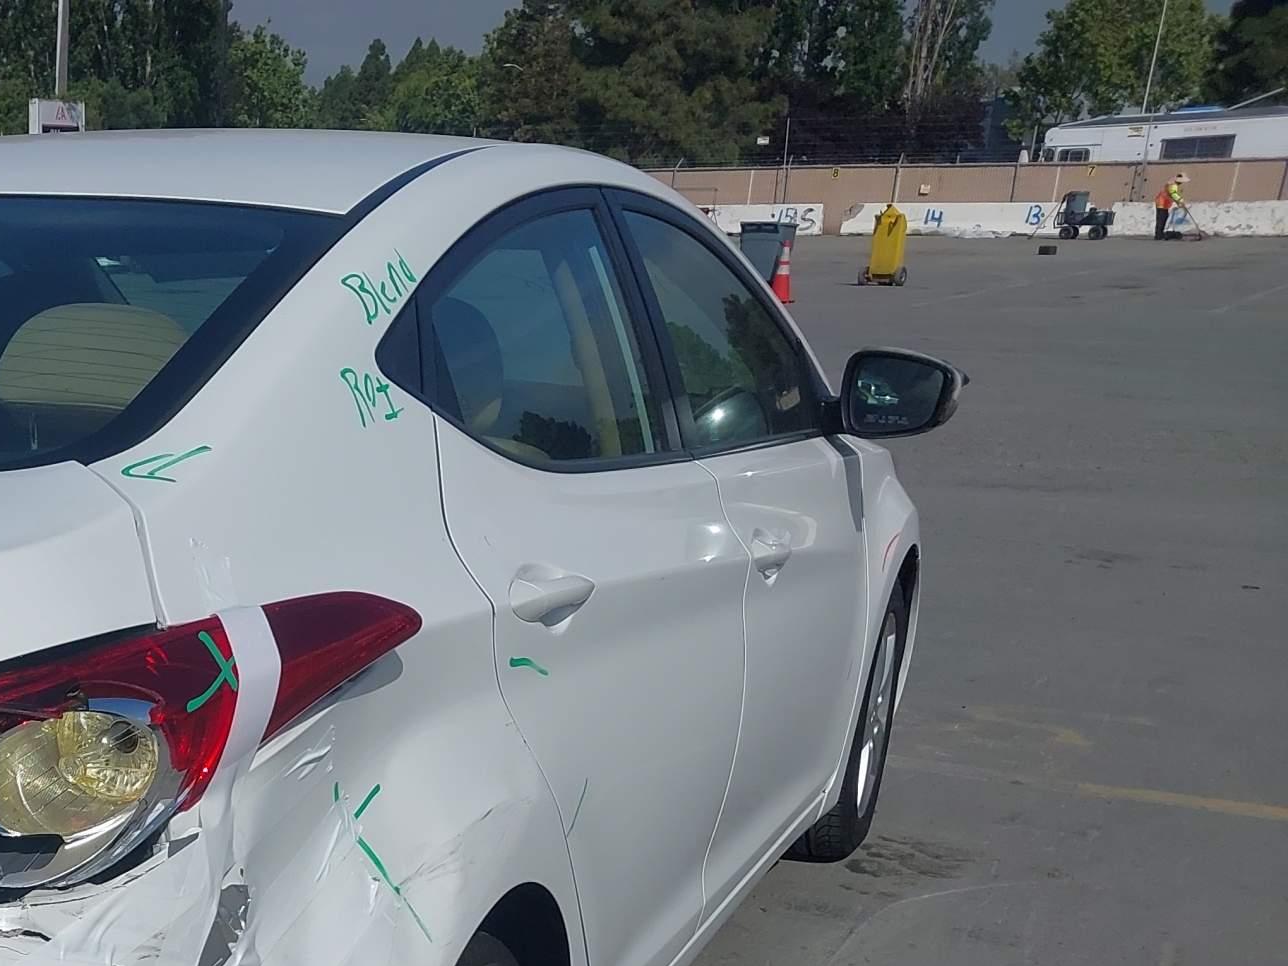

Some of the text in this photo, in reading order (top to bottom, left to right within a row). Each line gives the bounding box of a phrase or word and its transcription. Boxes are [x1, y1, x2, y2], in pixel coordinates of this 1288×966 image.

[1087, 166, 1096, 177] 7
[923, 208, 943, 228] 14
[1025, 204, 1042, 225] 13
[341, 248, 417, 325] Blend
